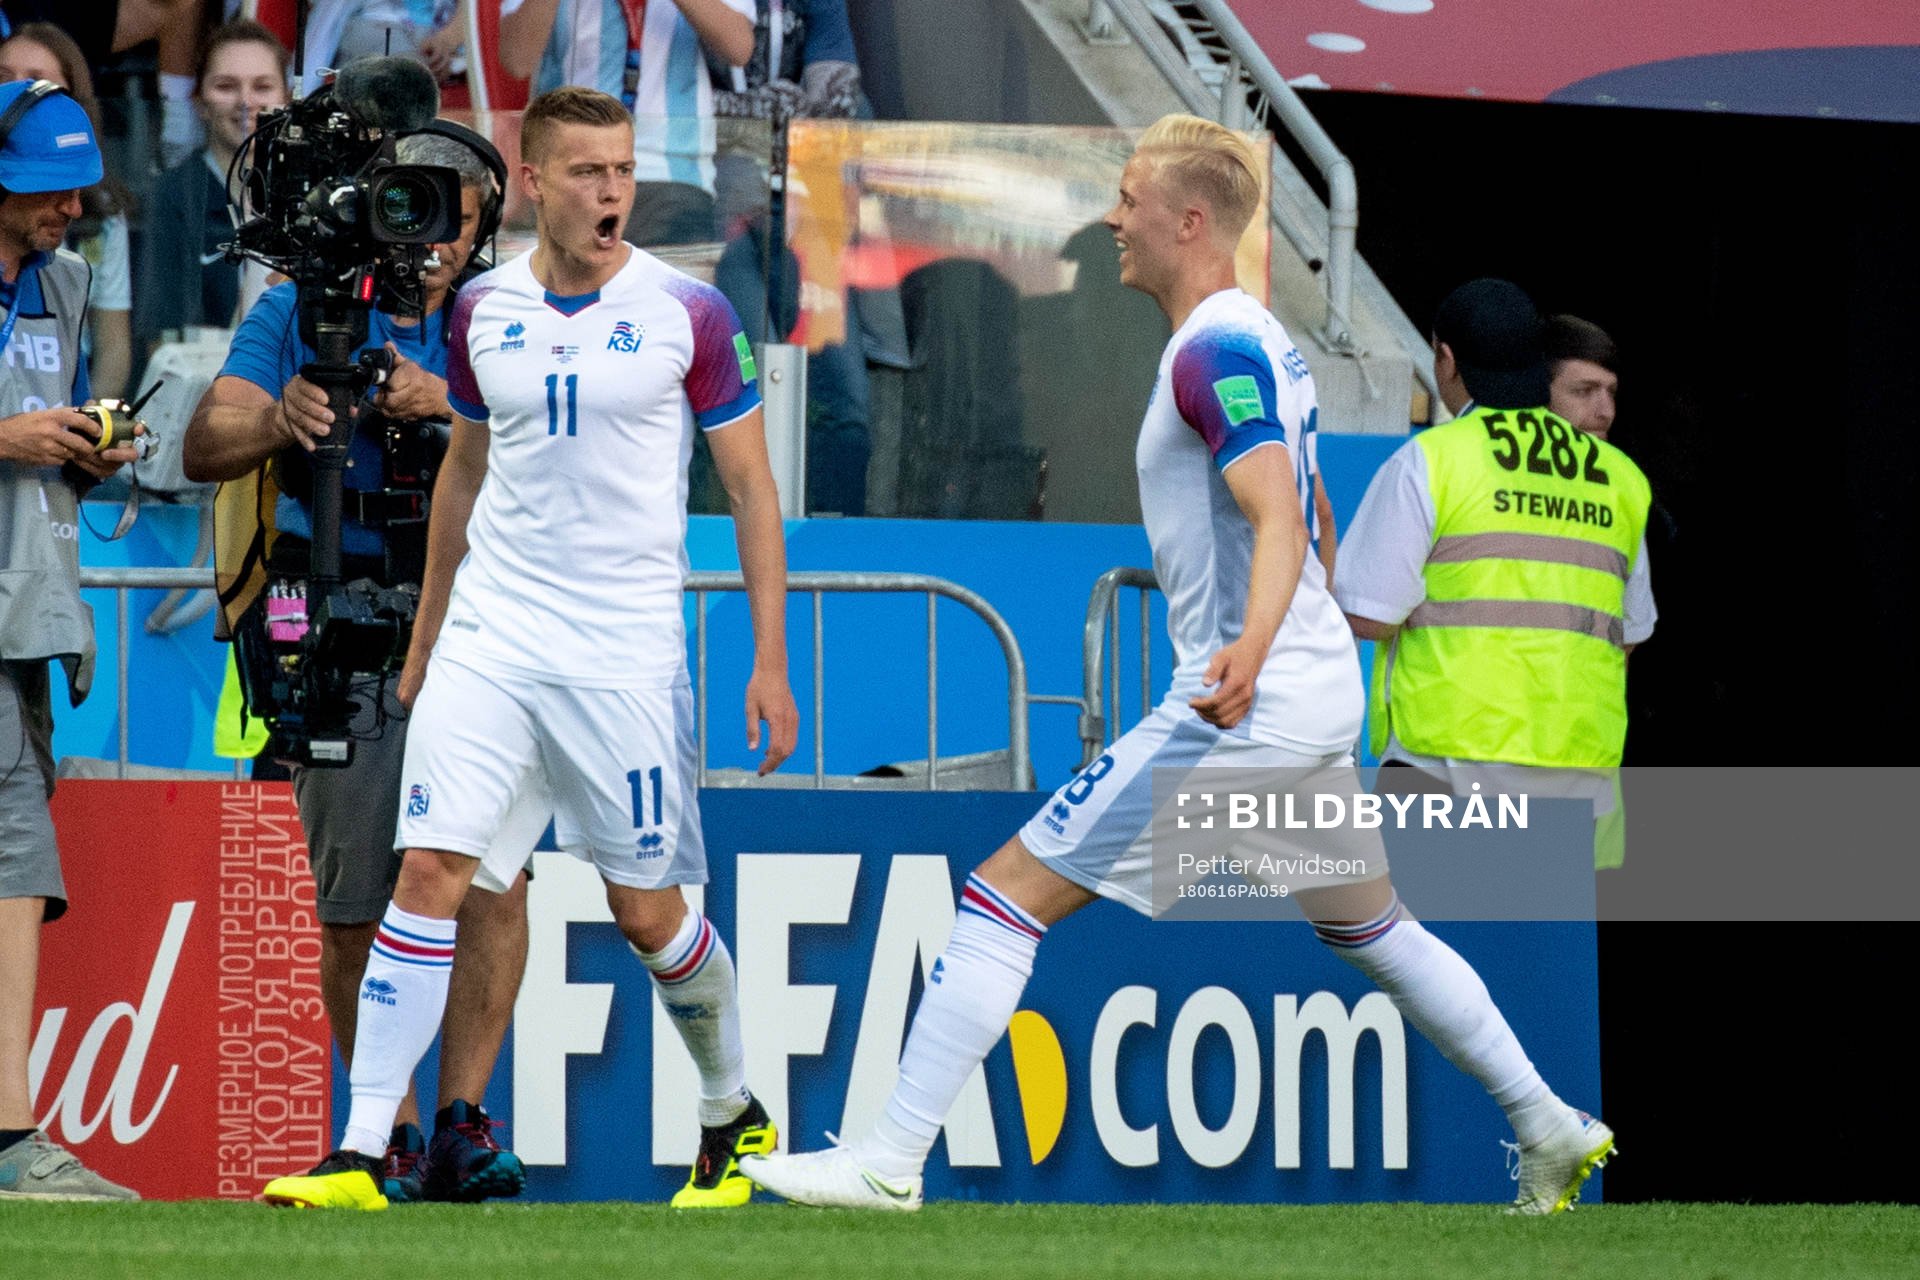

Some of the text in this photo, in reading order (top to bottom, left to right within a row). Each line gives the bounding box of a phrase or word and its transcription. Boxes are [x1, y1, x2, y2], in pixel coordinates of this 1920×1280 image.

[545, 373, 578, 436] 11
[1481, 410, 1610, 486] 5282
[1493, 489, 1613, 528] STEWARD
[626, 766, 663, 829] 11
[256, 784, 292, 961] ВРЕДИТ
[218, 784, 255, 1201] РЕЗМЕРНОЕ УПОТРЕБЛЕНИЕ
[288, 1034, 325, 1177] ШЕМУ
